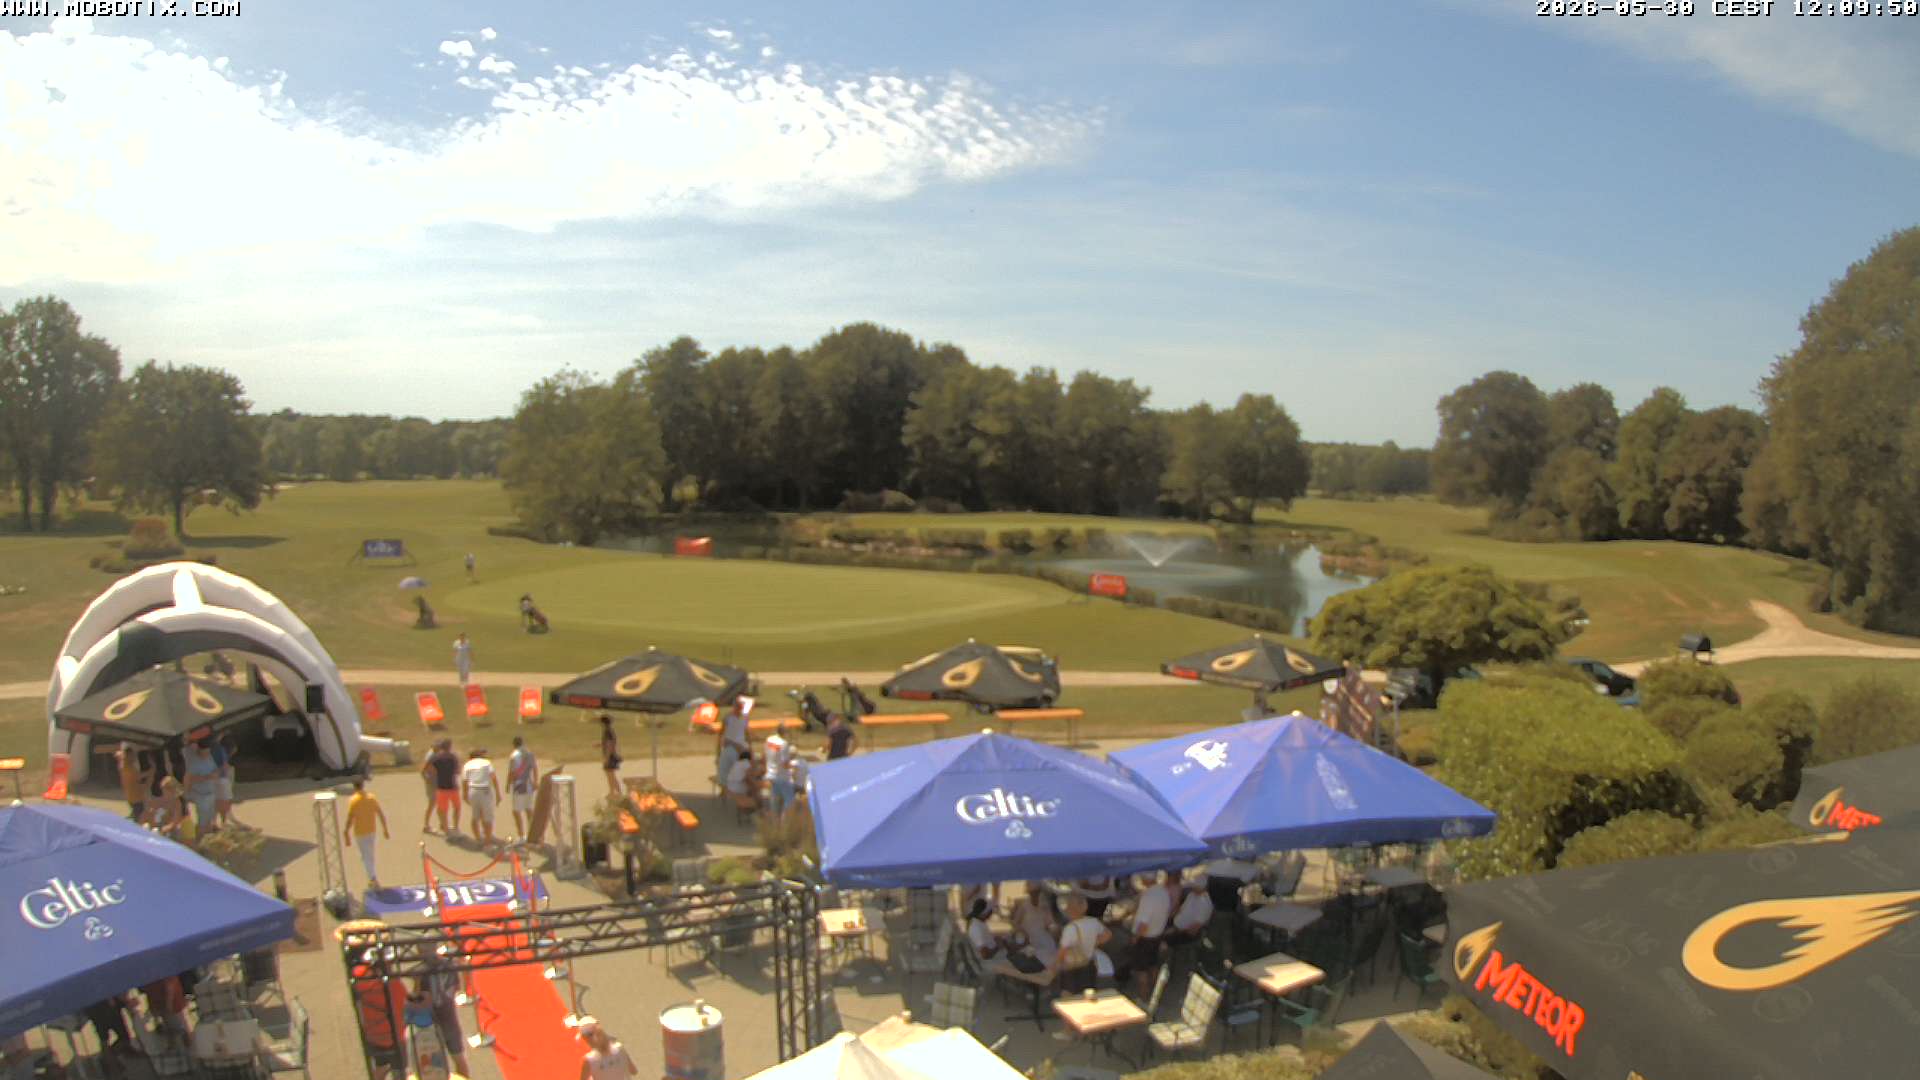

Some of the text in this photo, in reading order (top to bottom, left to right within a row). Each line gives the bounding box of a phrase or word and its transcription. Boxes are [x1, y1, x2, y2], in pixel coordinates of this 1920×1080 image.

[956, 787, 1061, 823] Celtic
[19, 876, 126, 929] Celtic
[1474, 950, 1585, 1057] METEOR
